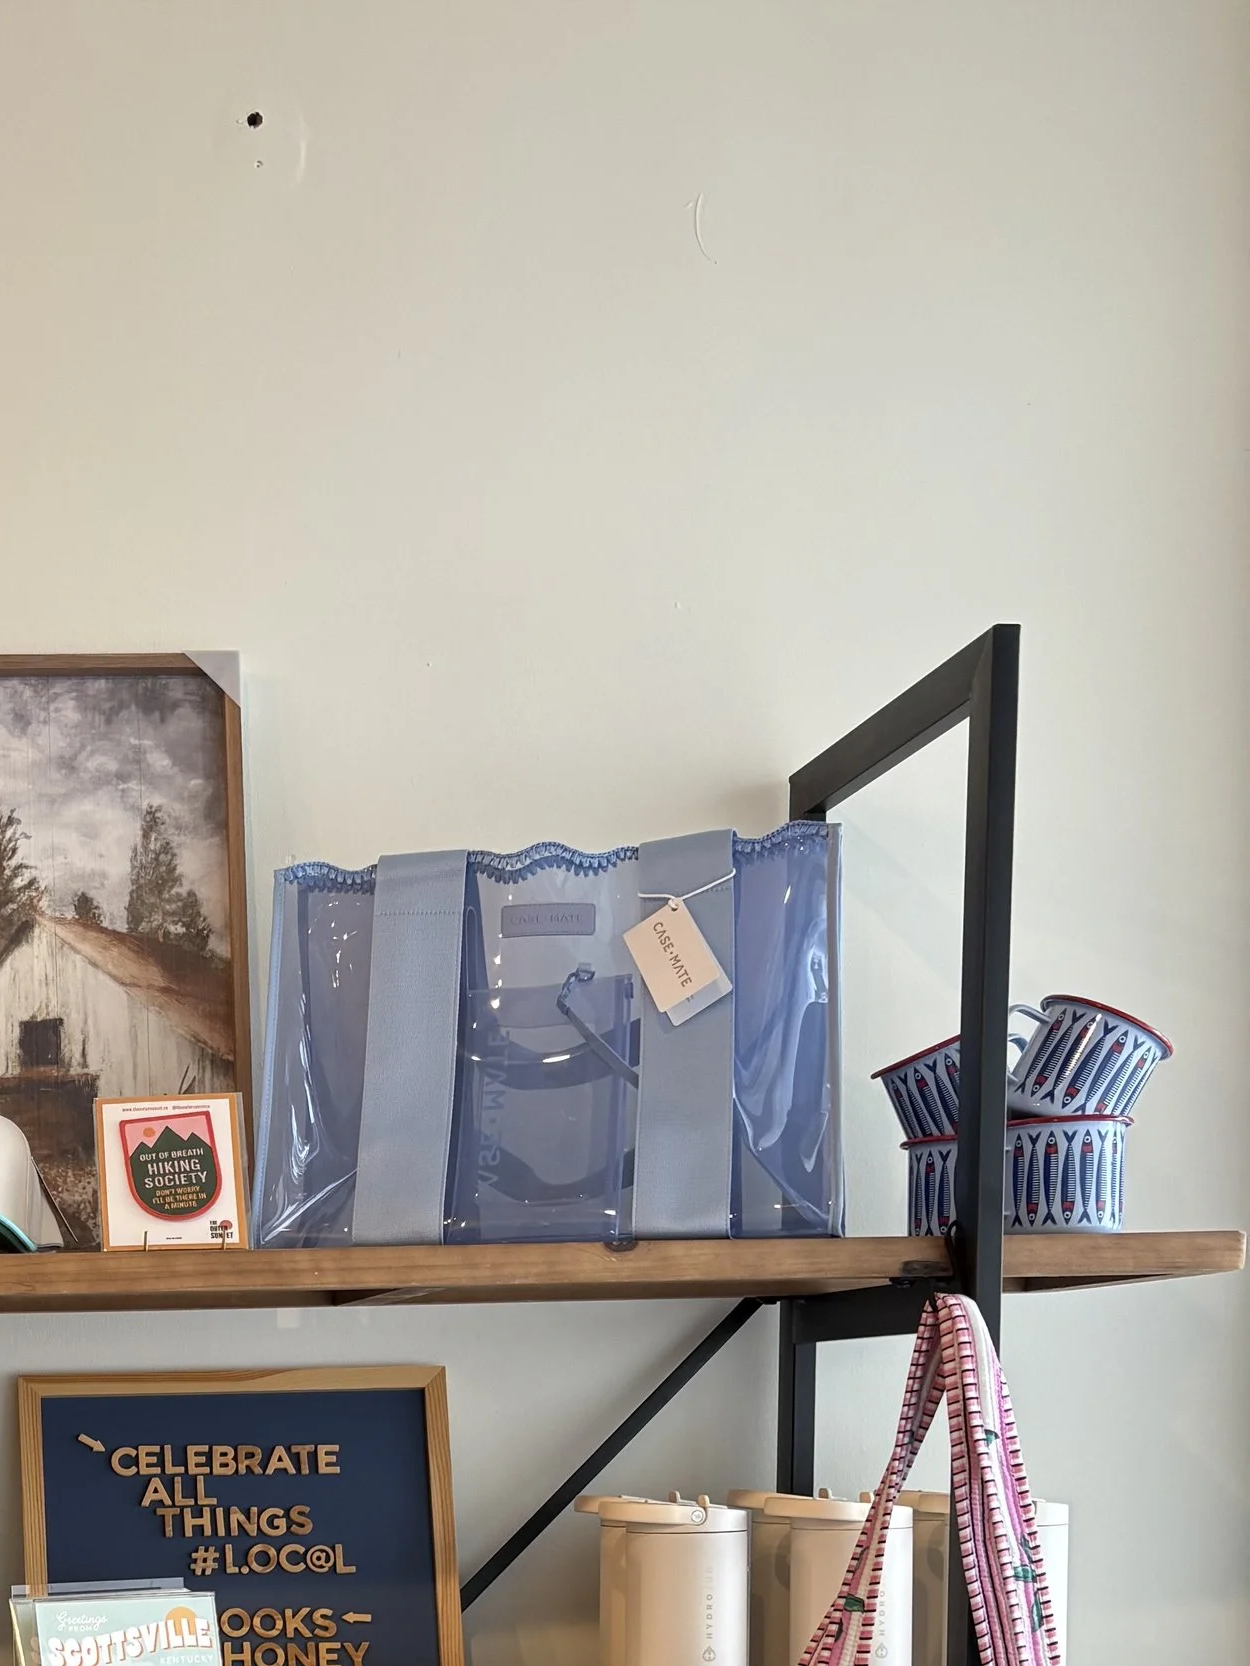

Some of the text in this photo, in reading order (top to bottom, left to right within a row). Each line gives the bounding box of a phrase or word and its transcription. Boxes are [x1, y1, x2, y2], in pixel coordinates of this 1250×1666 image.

[140, 1147, 204, 1162] OUT OF BREATH
[147, 1159, 201, 1175] HIKING
[144, 1171, 208, 1189] SOCIETY
[155, 1186, 200, 1197] DON'T WORRY
[111, 1444, 341, 1477] CELEBRATE
[141, 1475, 218, 1508] ALL
[156, 1505, 314, 1538] THINGS
[56, 1611, 108, 1632] Greetings
[220, 1607, 338, 1638] OOKS
[160, 1654, 213, 1665] KENTUCKY
